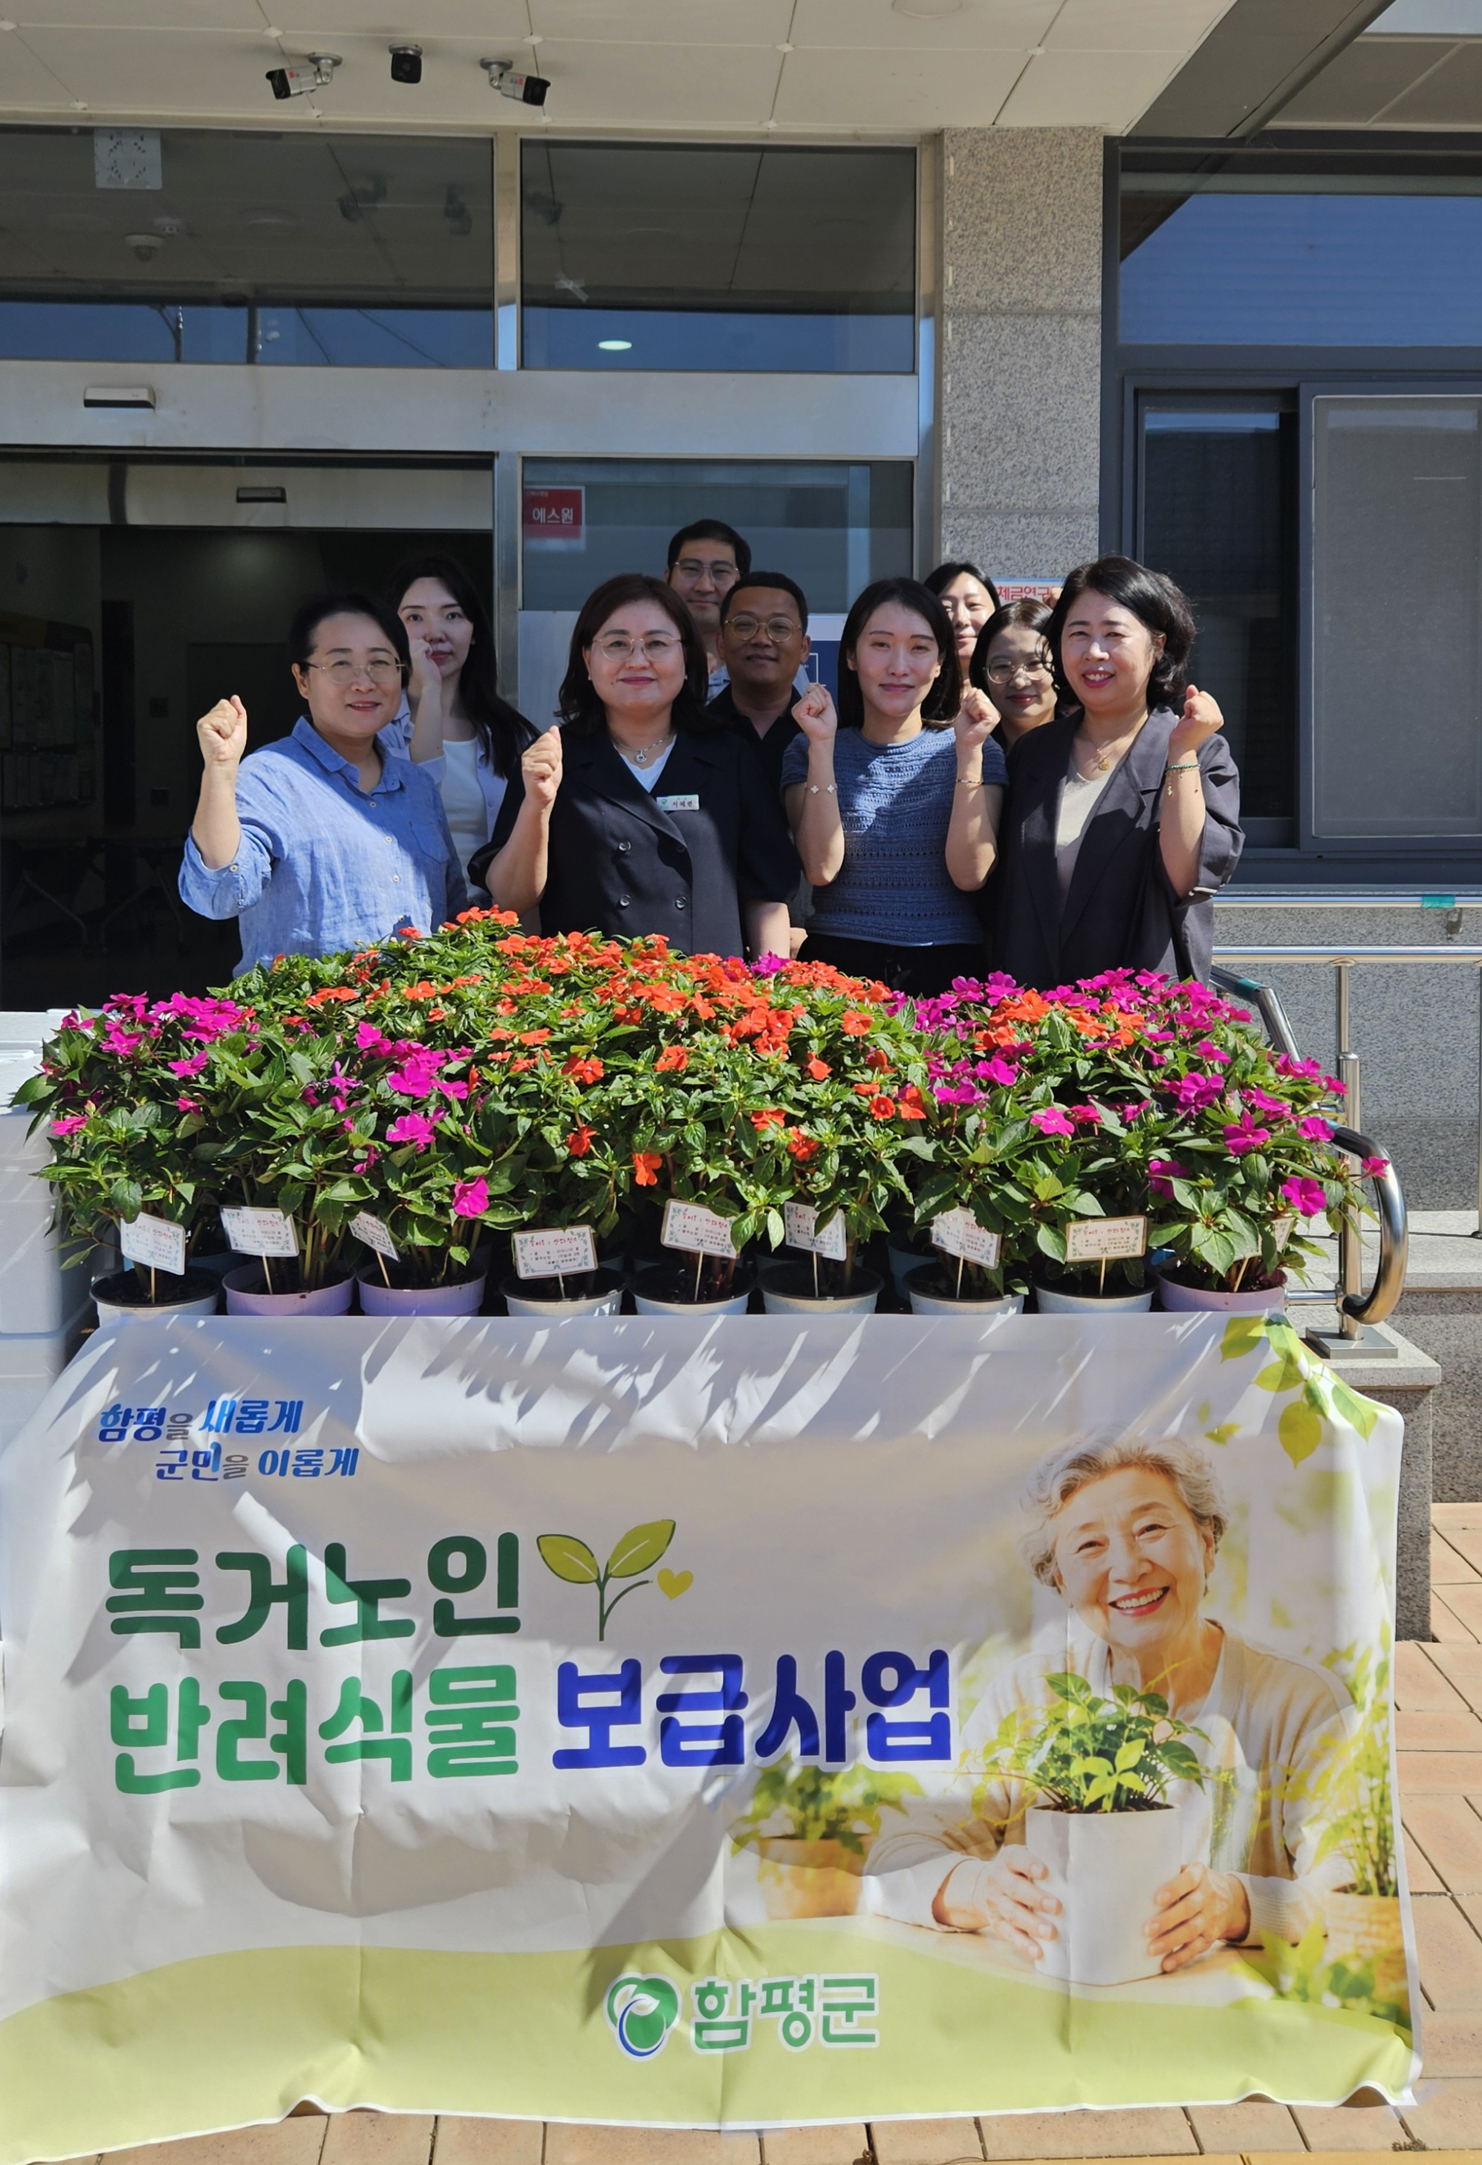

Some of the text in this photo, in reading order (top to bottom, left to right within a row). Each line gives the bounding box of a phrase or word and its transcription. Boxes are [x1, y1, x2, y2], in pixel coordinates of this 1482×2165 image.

[532, 507, 574, 525] 에스원
[997, 585, 1055, 601] 체금연구
[98, 1400, 304, 1442] 함평을 새롭게
[155, 1441, 360, 1482] 군민을 이롭게
[105, 1531, 521, 1651] 독거노인
[110, 1648, 953, 1794] 반려식물 보급사업
[694, 1978, 876, 2050] 함평군
